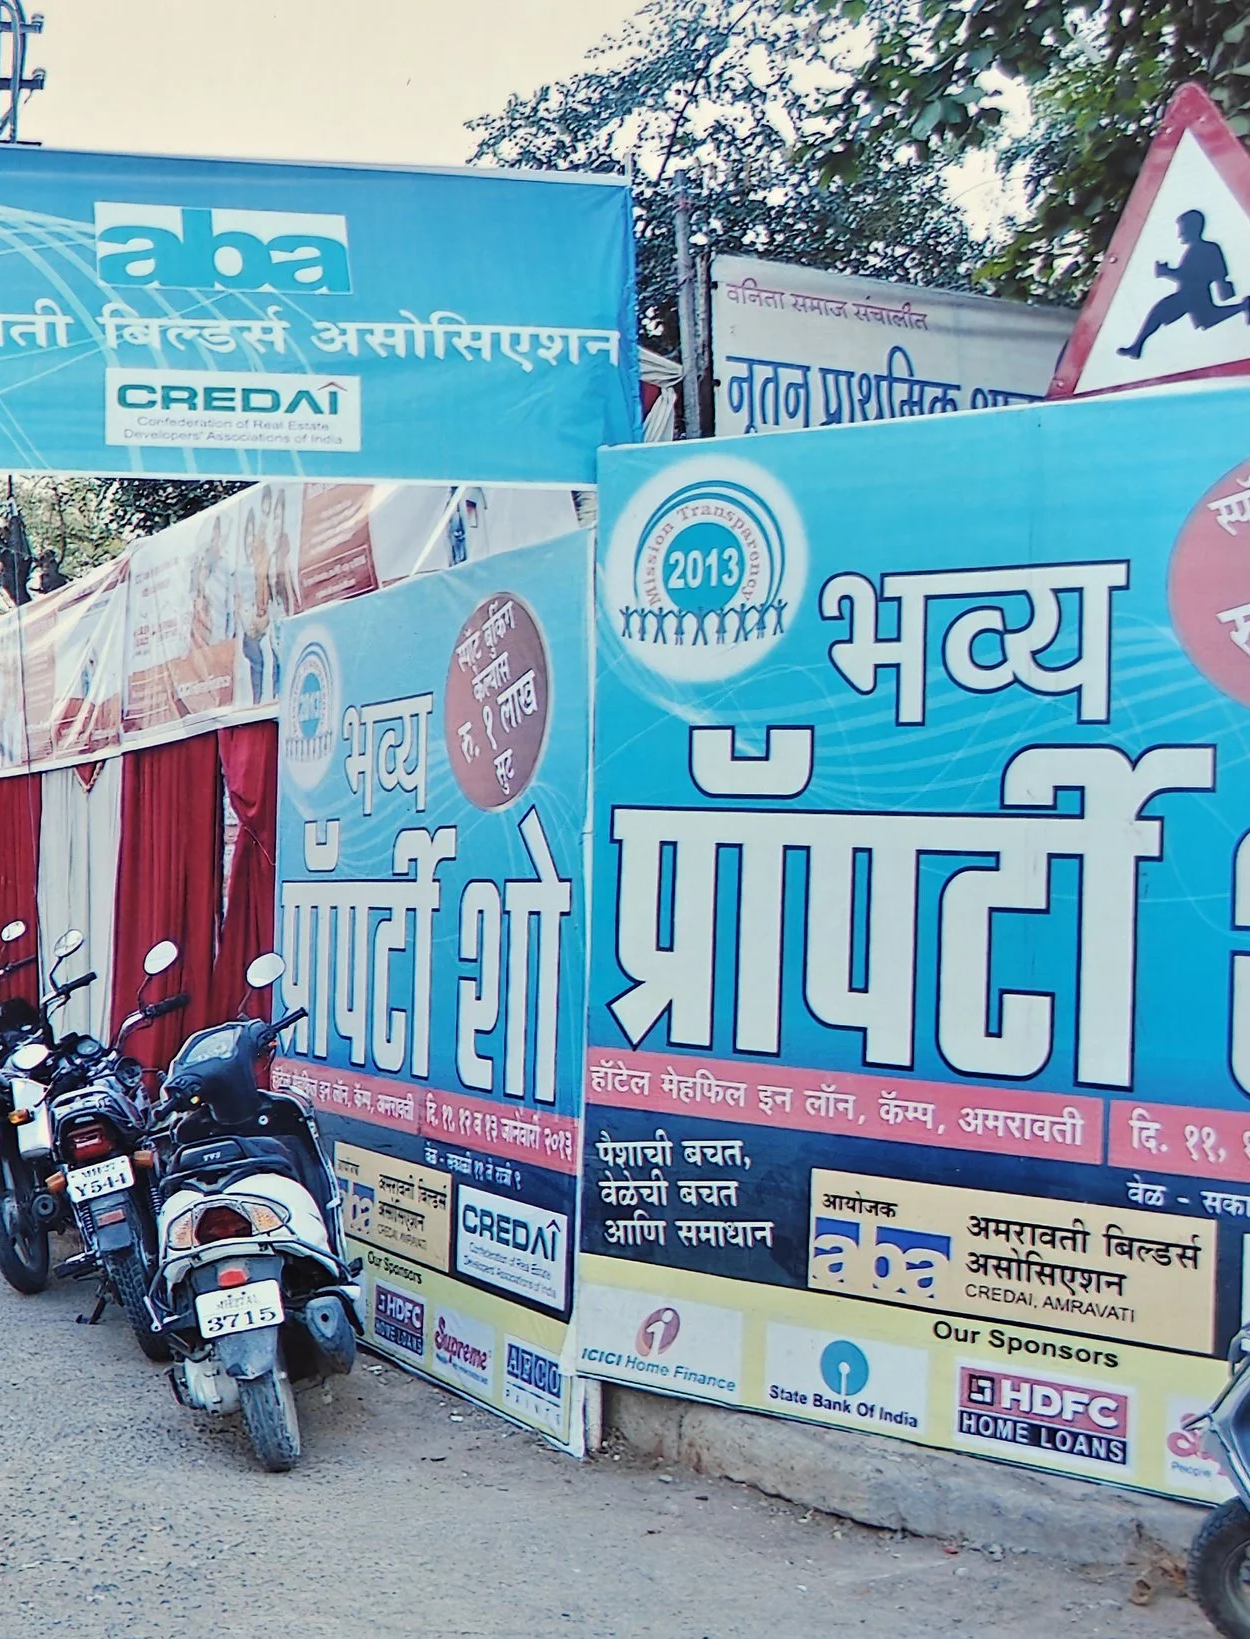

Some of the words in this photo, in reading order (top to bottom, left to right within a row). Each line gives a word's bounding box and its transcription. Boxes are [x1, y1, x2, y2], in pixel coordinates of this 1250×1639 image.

[97, 207, 351, 294] aba
[726, 278, 786, 311] वनिता
[791, 293, 848, 321] समाज
[852, 295, 929, 332] संचालीत
[96, 302, 291, 355] बिल्डर्स
[310, 309, 621, 372] असोसिएशन
[117, 382, 348, 416] CREDAI
[136, 415, 233, 430] Confederation
[236, 416, 249, 430] of
[253, 419, 284, 431] Real
[288, 421, 330, 432] Estate
[206, 430, 290, 443] Associations
[294, 432, 306, 444] of
[311, 434, 344, 445] India
[667, 547, 741, 590] 2013
[818, 560, 1131, 727] भव्य
[496, 669, 539, 733] लाख
[342, 691, 434, 816] भव्य
[606, 724, 1218, 1091] प्रॉपर्टी
[455, 805, 572, 1104] शो
[590, 1063, 651, 1096] हॉटेल
[661, 1066, 747, 1108] मेहफिल
[759, 1085, 793, 1115] इन
[805, 1082, 864, 1126] लॉन,
[878, 1090, 946, 1135] कॅम्प,
[958, 1103, 1085, 1147] अमरावती
[595, 1128, 674, 1169] पैशाची
[681, 1139, 752, 1171] बचत,
[1128, 1106, 1168, 1155] दि.
[1184, 1124, 1227, 1164] ११,
[598, 1168, 670, 1207] वेळेची
[677, 1181, 740, 1207] बचत
[821, 1190, 899, 1219] आयोजक
[1125, 1173, 1168, 1206] वेळ
[604, 1209, 668, 1247] आणि
[675, 1220, 775, 1249] समाधान
[966, 1214, 1091, 1255] अमरावती
[1102, 1222, 1202, 1271] बिल्डर्स
[965, 1247, 1128, 1298] असोसिएशन
[206, 1305, 278, 1334] 3715
[386, 1293, 423, 1329] HDFC
[1042, 1296, 1136, 1324] AMRAVATI
[932, 1319, 982, 1345] Our
[988, 1329, 1120, 1369] Sponsors
[581, 1347, 623, 1367] ICICI
[625, 1355, 670, 1378] Home
[674, 1365, 737, 1393] Finance
[769, 1384, 808, 1406] State
[812, 1394, 852, 1415] Bank
[856, 1402, 876, 1420] Of
[879, 1405, 919, 1429] India
[1001, 1378, 1120, 1430] HDFC
[961, 1411, 1030, 1445] HOME
[1040, 1427, 1125, 1464] LOANS
